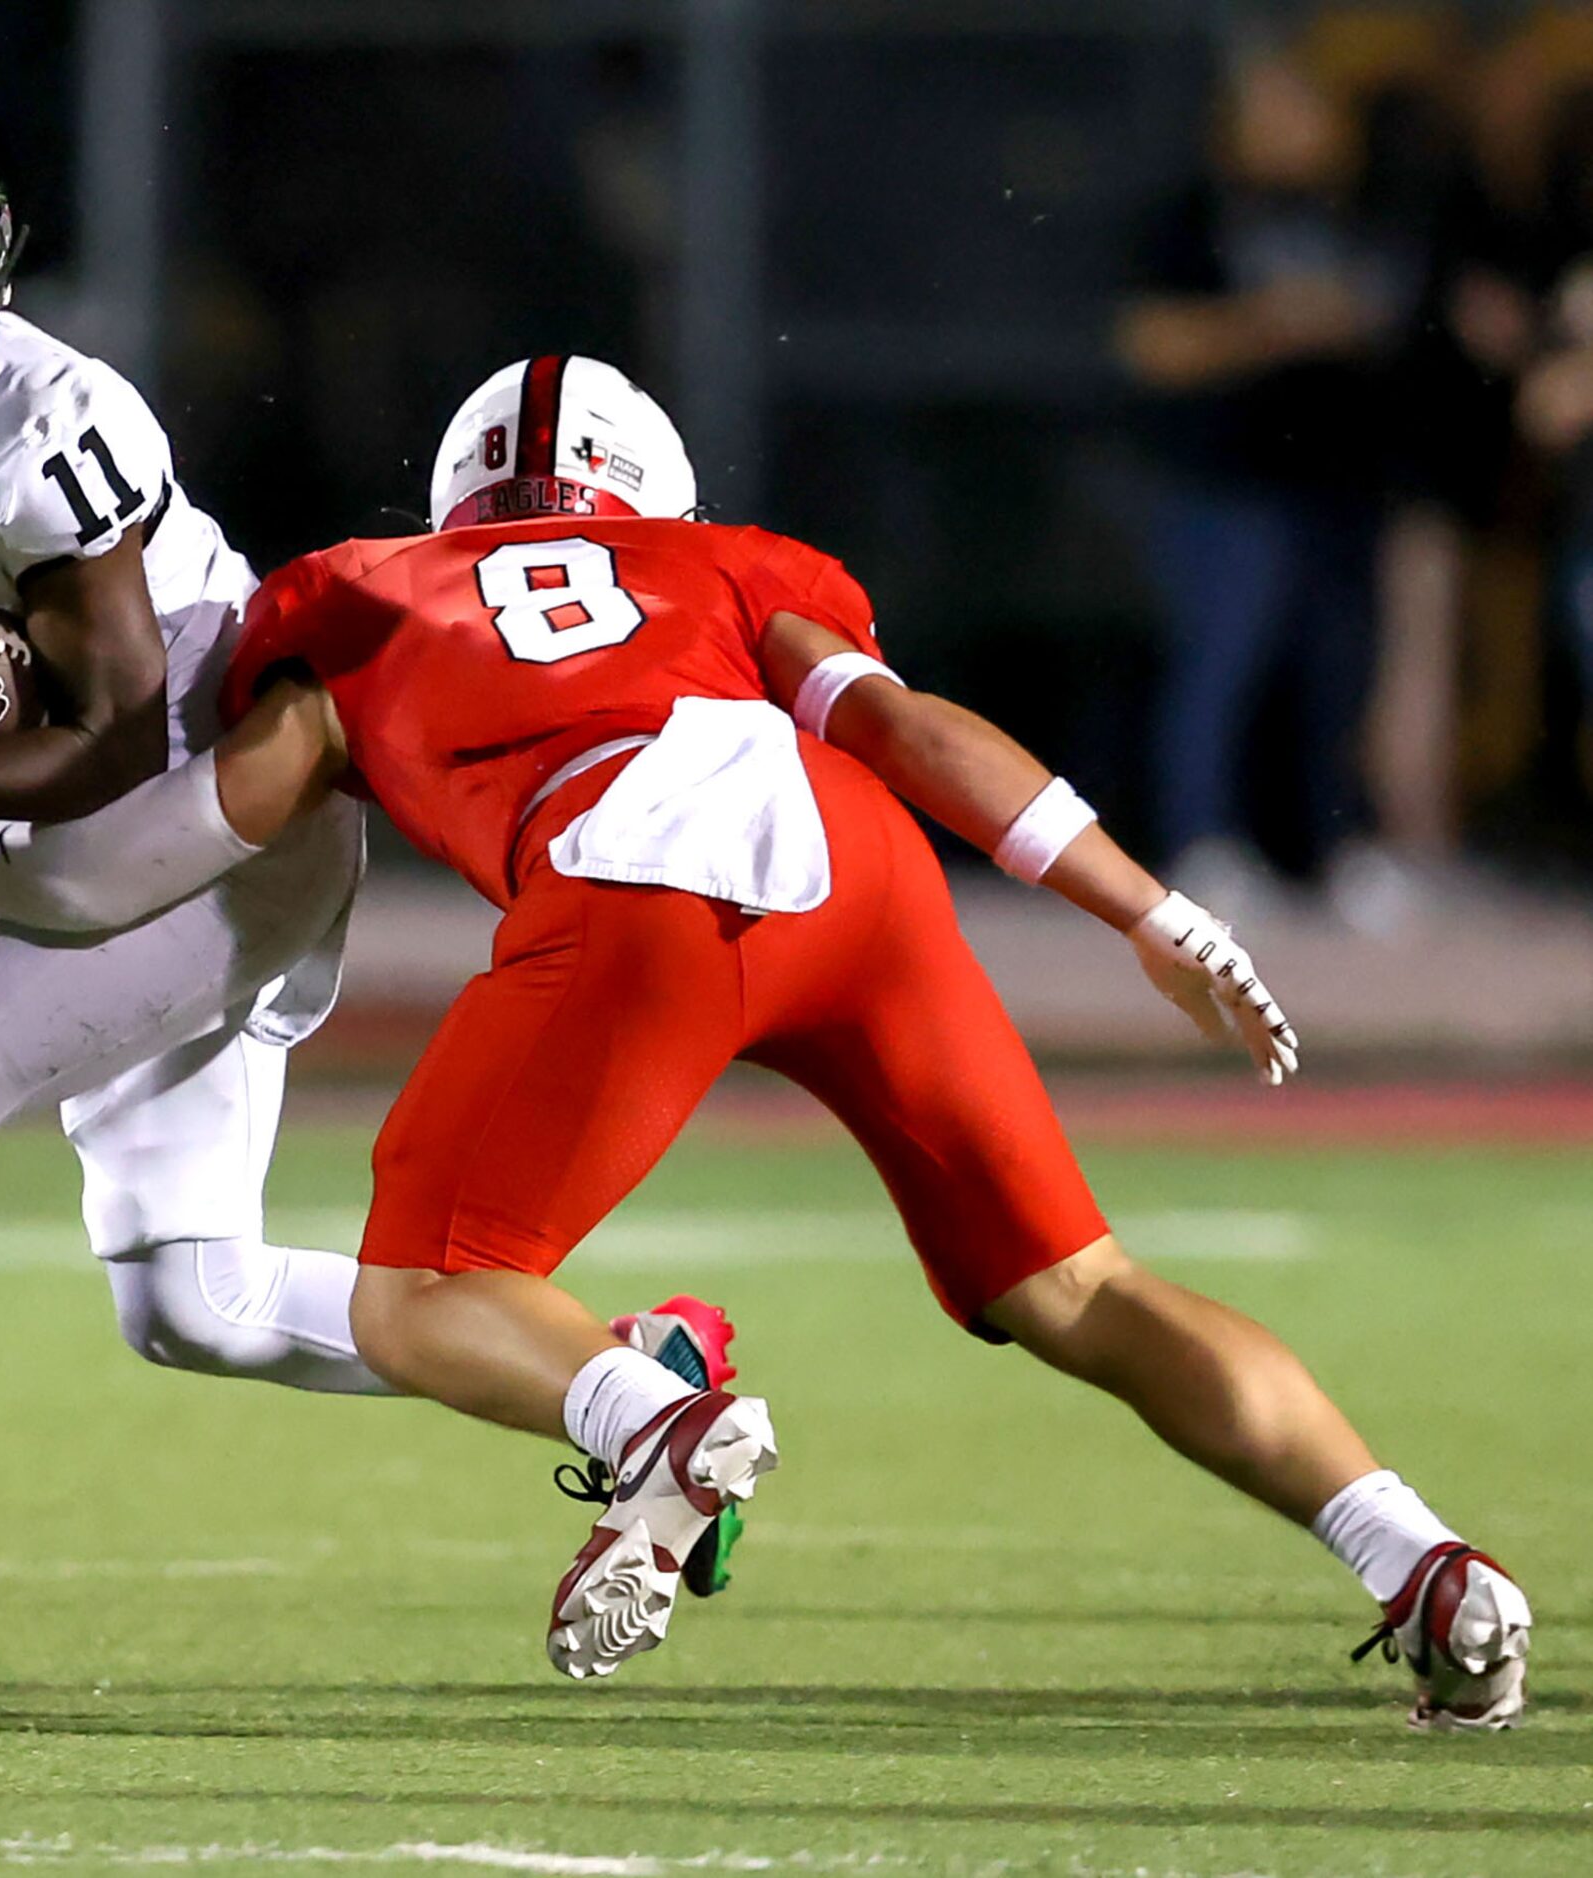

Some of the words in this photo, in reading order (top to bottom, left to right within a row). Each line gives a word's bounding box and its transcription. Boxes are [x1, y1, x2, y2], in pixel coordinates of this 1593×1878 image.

[42, 424, 147, 547] 11
[475, 478, 596, 521] EAGLES
[484, 425, 507, 470] 8
[473, 535, 647, 664] 8
[1173, 927, 1290, 1037] JORDAN
